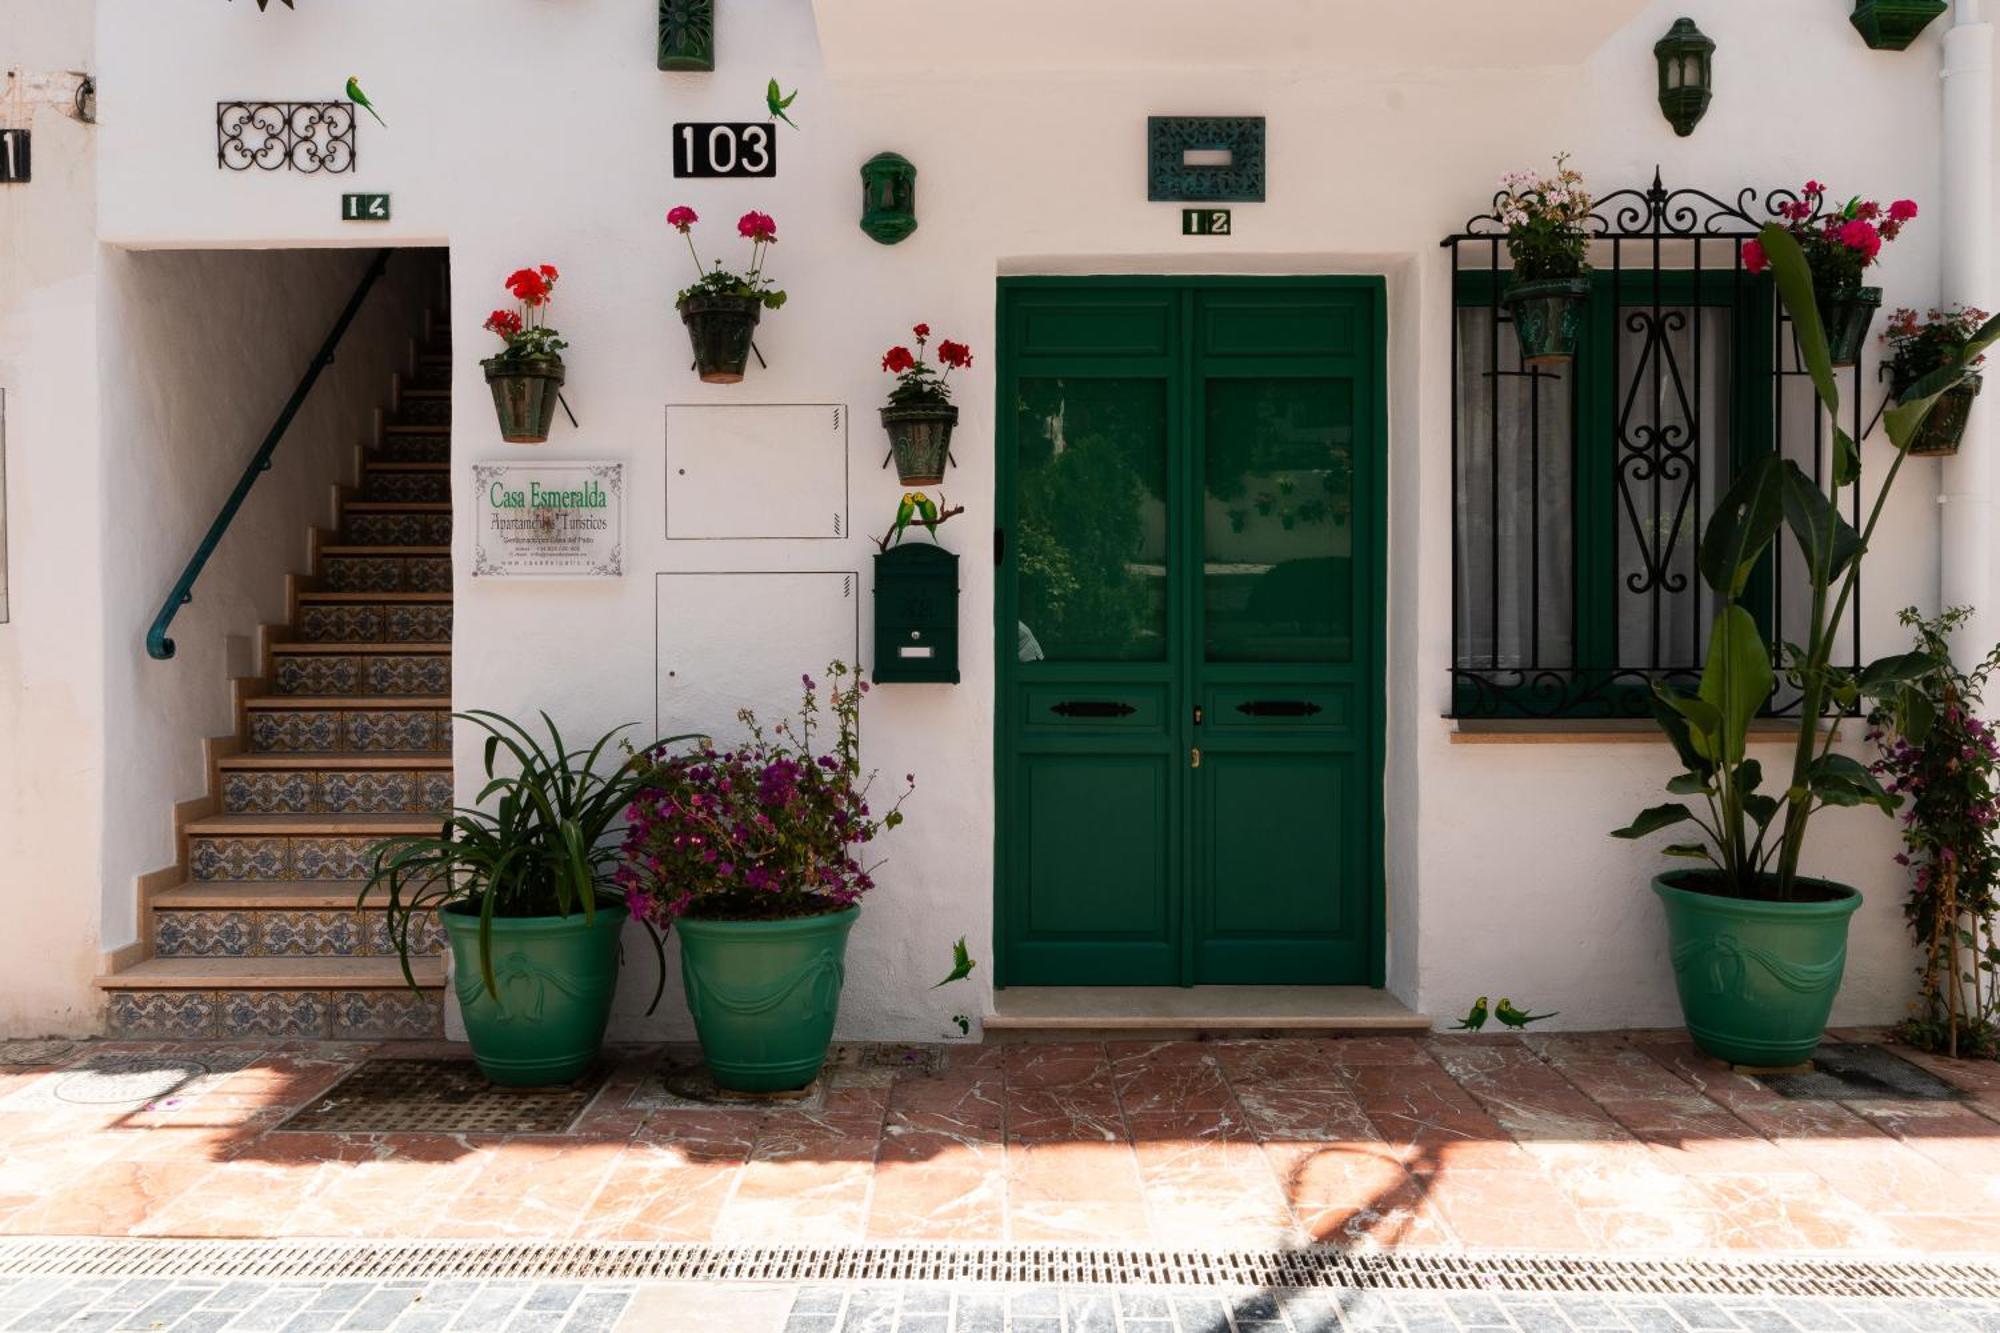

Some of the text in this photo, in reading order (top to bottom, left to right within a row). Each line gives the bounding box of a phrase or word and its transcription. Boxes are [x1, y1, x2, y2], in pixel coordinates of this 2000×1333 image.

[682, 125, 769, 173] 103
[350, 196, 386, 217] 14
[1191, 212, 1228, 233] 12
[490, 480, 607, 509] Casa Esmeralda
